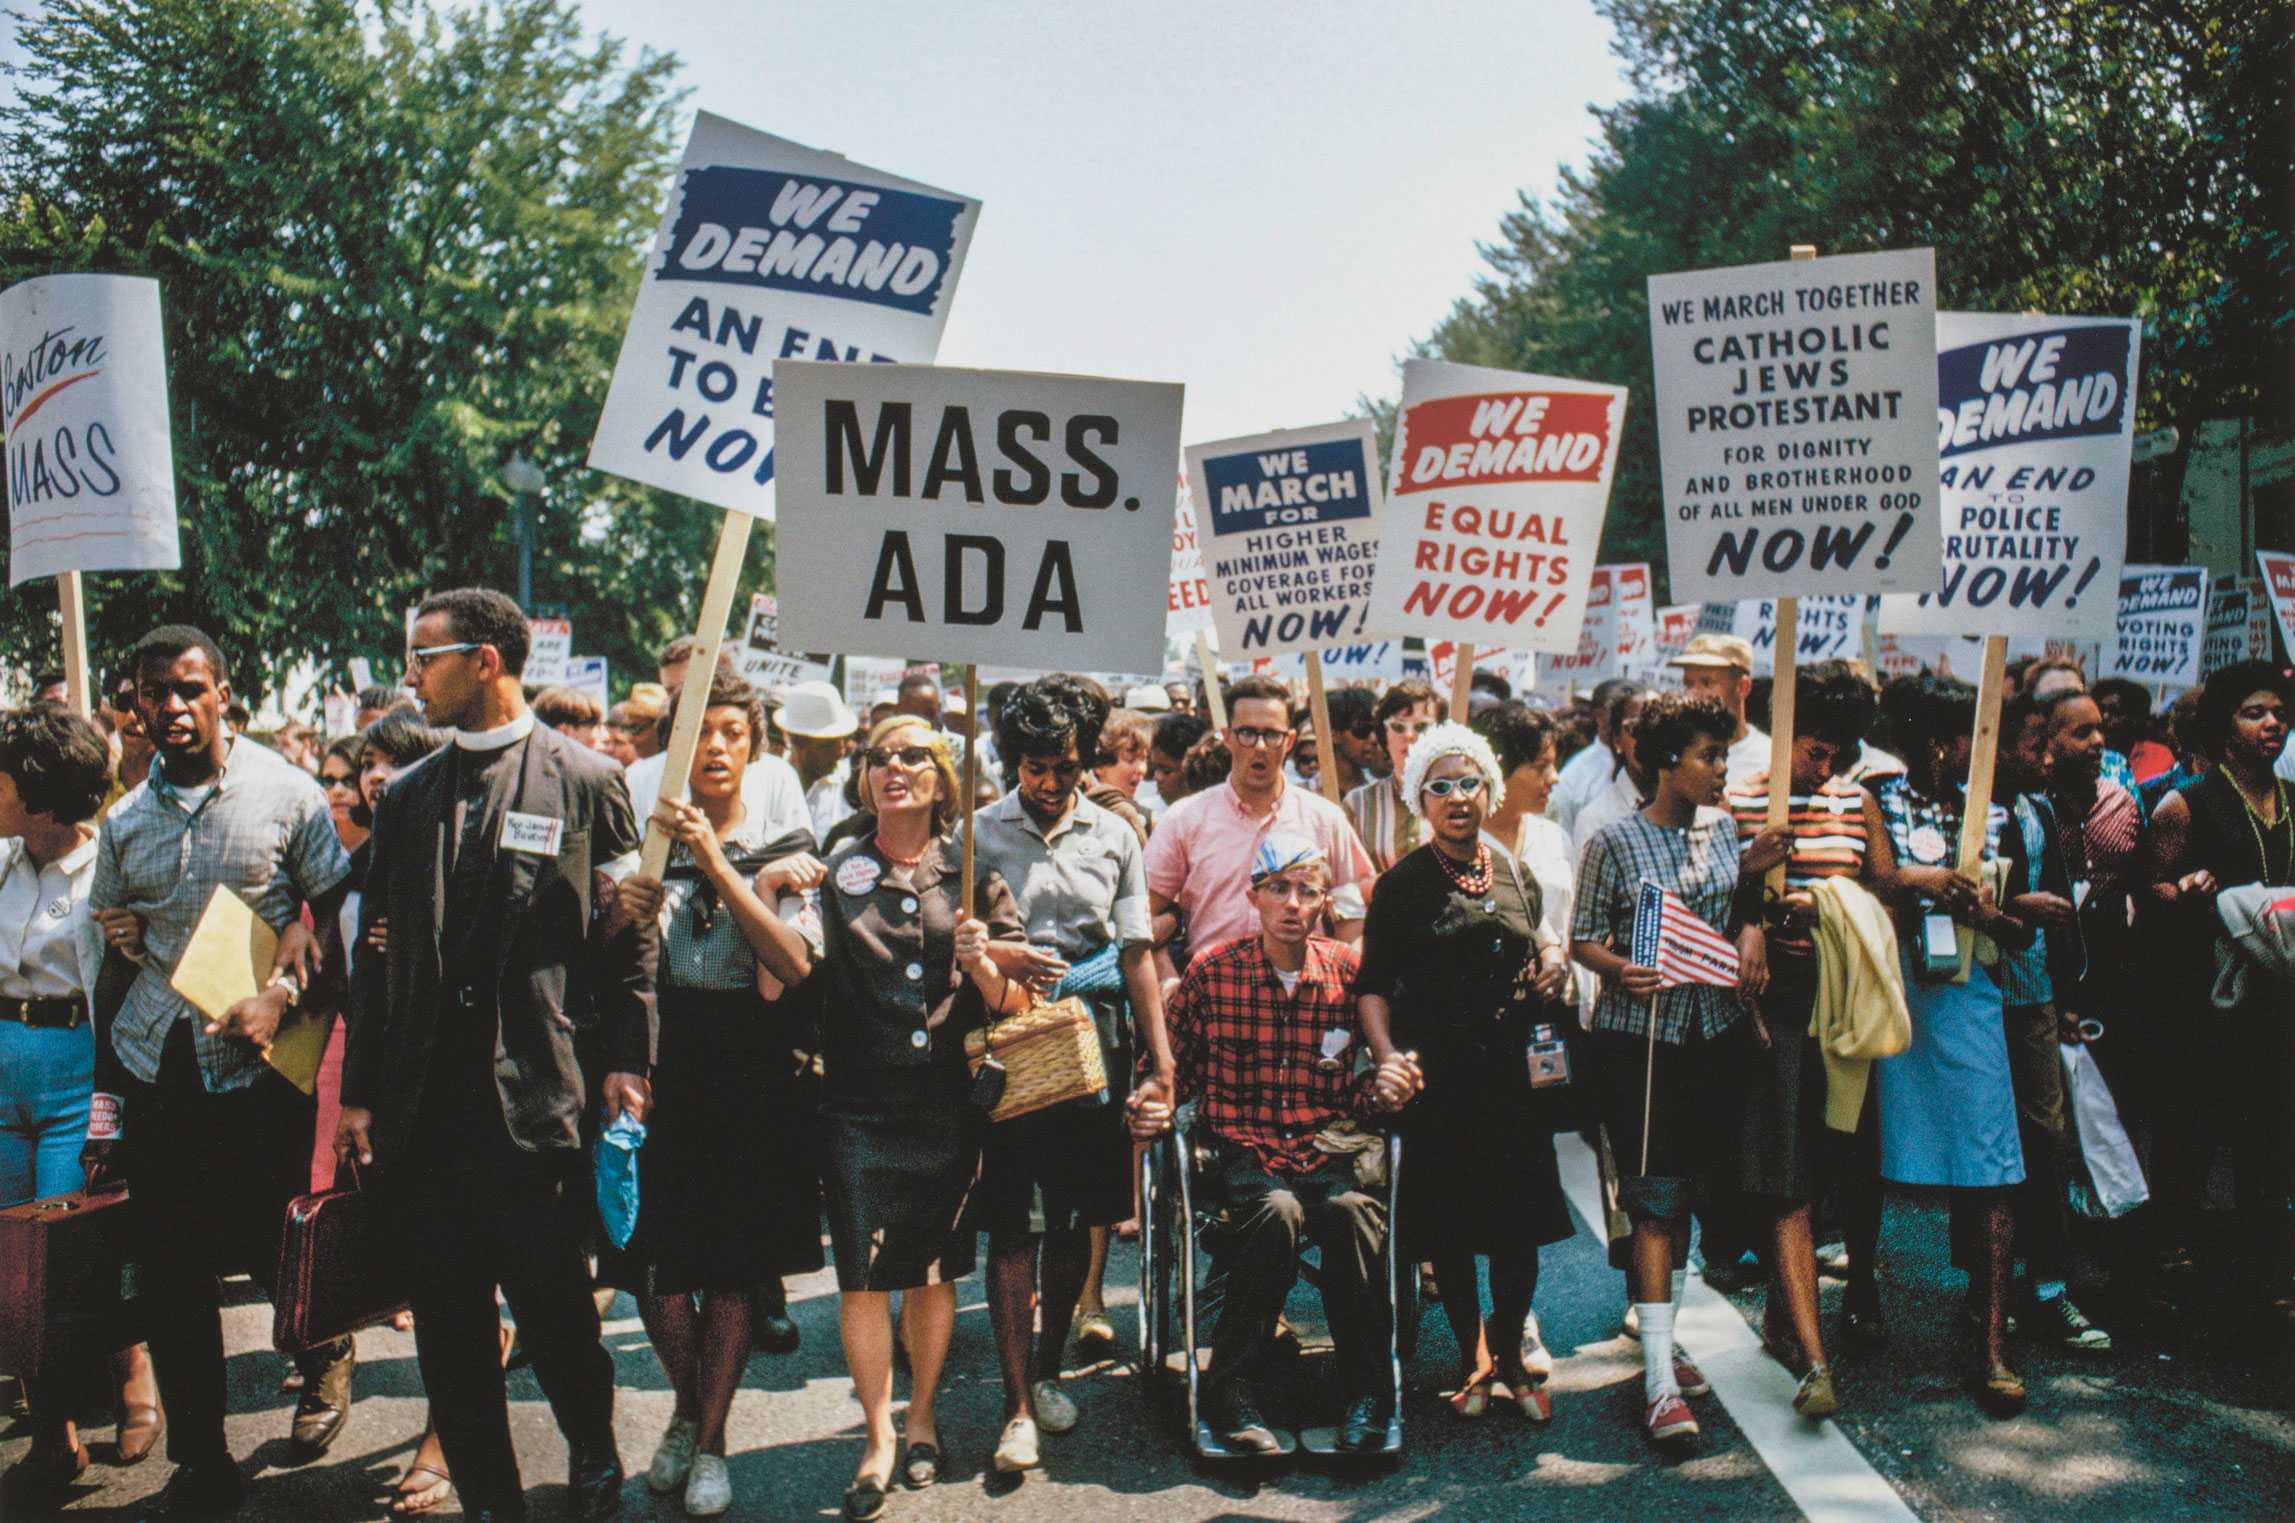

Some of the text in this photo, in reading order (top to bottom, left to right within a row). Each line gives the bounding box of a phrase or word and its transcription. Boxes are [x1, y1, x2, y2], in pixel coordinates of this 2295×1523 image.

[769, 179, 880, 233] WE
[678, 223, 939, 296] DEMAND
[1662, 280, 1920, 324] WE MARCH TOGETHER
[670, 296, 898, 364] AN EN
[1693, 322, 1889, 365] CATHOLIC
[5, 326, 107, 418] Boston
[667, 346, 738, 403] TO
[1733, 359, 1849, 395] JEWS
[1980, 335, 2066, 393] WE
[1470, 396, 1550, 438] WE
[1687, 391, 1902, 433] PROTESTANT
[1937, 371, 2118, 450] DEMAND
[643, 407, 774, 486] NO
[825, 399, 1140, 512] MASS.
[1258, 451, 1309, 477] WE
[1411, 432, 1600, 484] DEMAND
[1723, 438, 1872, 465] FOR DIGNITY
[12, 422, 120, 512] MASS
[1685, 465, 1912, 495] AND BROTHERHOOD
[1940, 465, 2097, 491] AN END
[1221, 471, 1357, 514] MARCH
[1679, 492, 1921, 521] OF ALL MEN UNDER GOD
[1988, 493, 2024, 503] TO
[1265, 507, 1320, 525] FOR
[1424, 502, 1568, 545] EQUAL
[1960, 506, 2061, 531] POLICE
[1247, 526, 1348, 552] HIGHER
[1706, 512, 1914, 576] NOW!
[1943, 535, 2079, 560] RUTALITY
[864, 530, 1084, 634] ADA
[1216, 550, 1309, 578] MINIMUM
[1227, 569, 1330, 596] COVERAGE
[1414, 540, 1569, 586] RIGHTS
[1236, 581, 1372, 613] ALL WORKERS
[2118, 587, 2198, 612] DEMAND
[2140, 574, 2175, 593] WE
[1403, 580, 1567, 627] NOW!
[1759, 602, 1848, 630] RHTS
[1242, 600, 1370, 649] NOW!
[1752, 625, 1848, 658] NW!
[2116, 619, 2194, 638] VOTING
[1298, 641, 1389, 665] OW!
[2115, 653, 2189, 675] NOW!
[2118, 637, 2188, 654] RIGHTS
